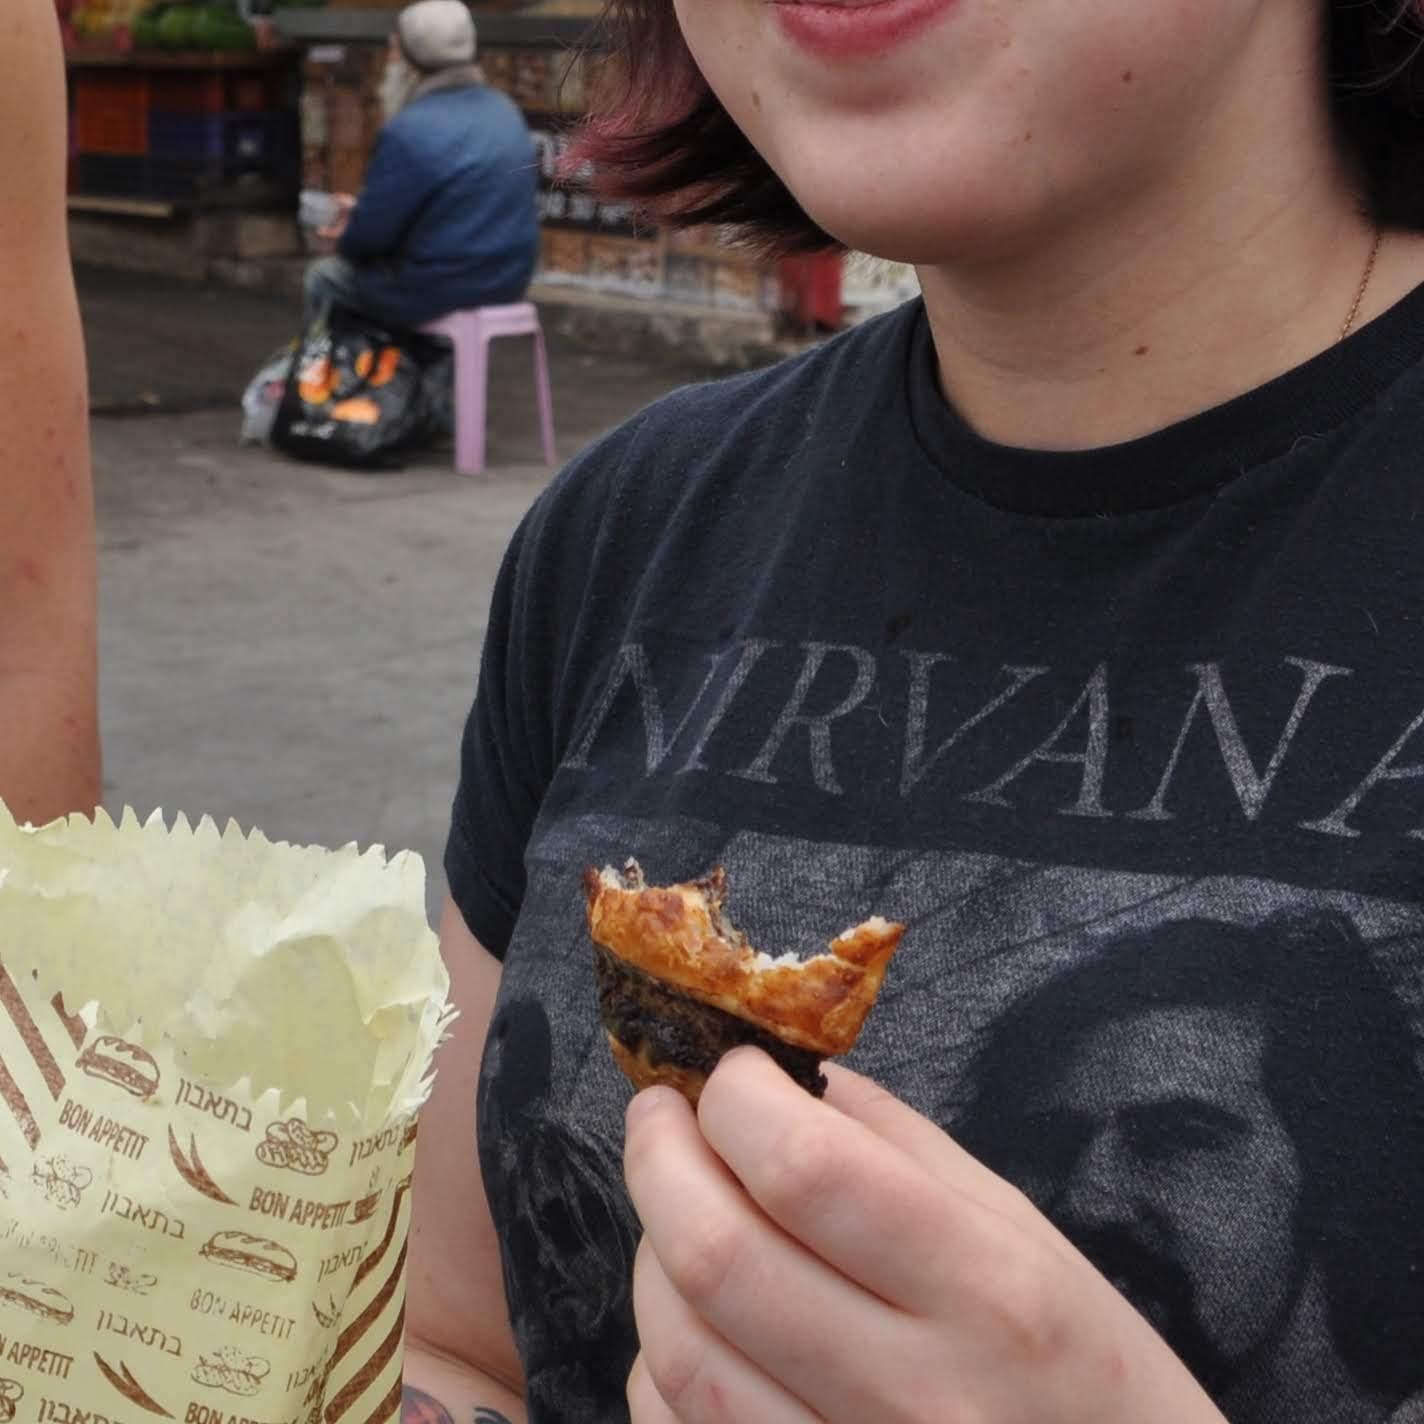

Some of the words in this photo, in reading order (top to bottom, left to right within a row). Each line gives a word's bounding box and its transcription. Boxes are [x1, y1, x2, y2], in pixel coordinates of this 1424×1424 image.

[175, 1078, 253, 1132] בתאבון
[58, 1099, 93, 1136] BON
[87, 1115, 150, 1160] APPETIT
[100, 1190, 185, 1239] בתאבון
[249, 1187, 290, 1219] BON
[289, 1198, 351, 1230] APPETIT
[317, 1240, 368, 1283] תאבון
[96, 1310, 182, 1357] בתאבון
[190, 1288, 227, 1316] BON
[229, 1302, 296, 1339] APPETIT
[7, 1342, 74, 1379] APPETIT
